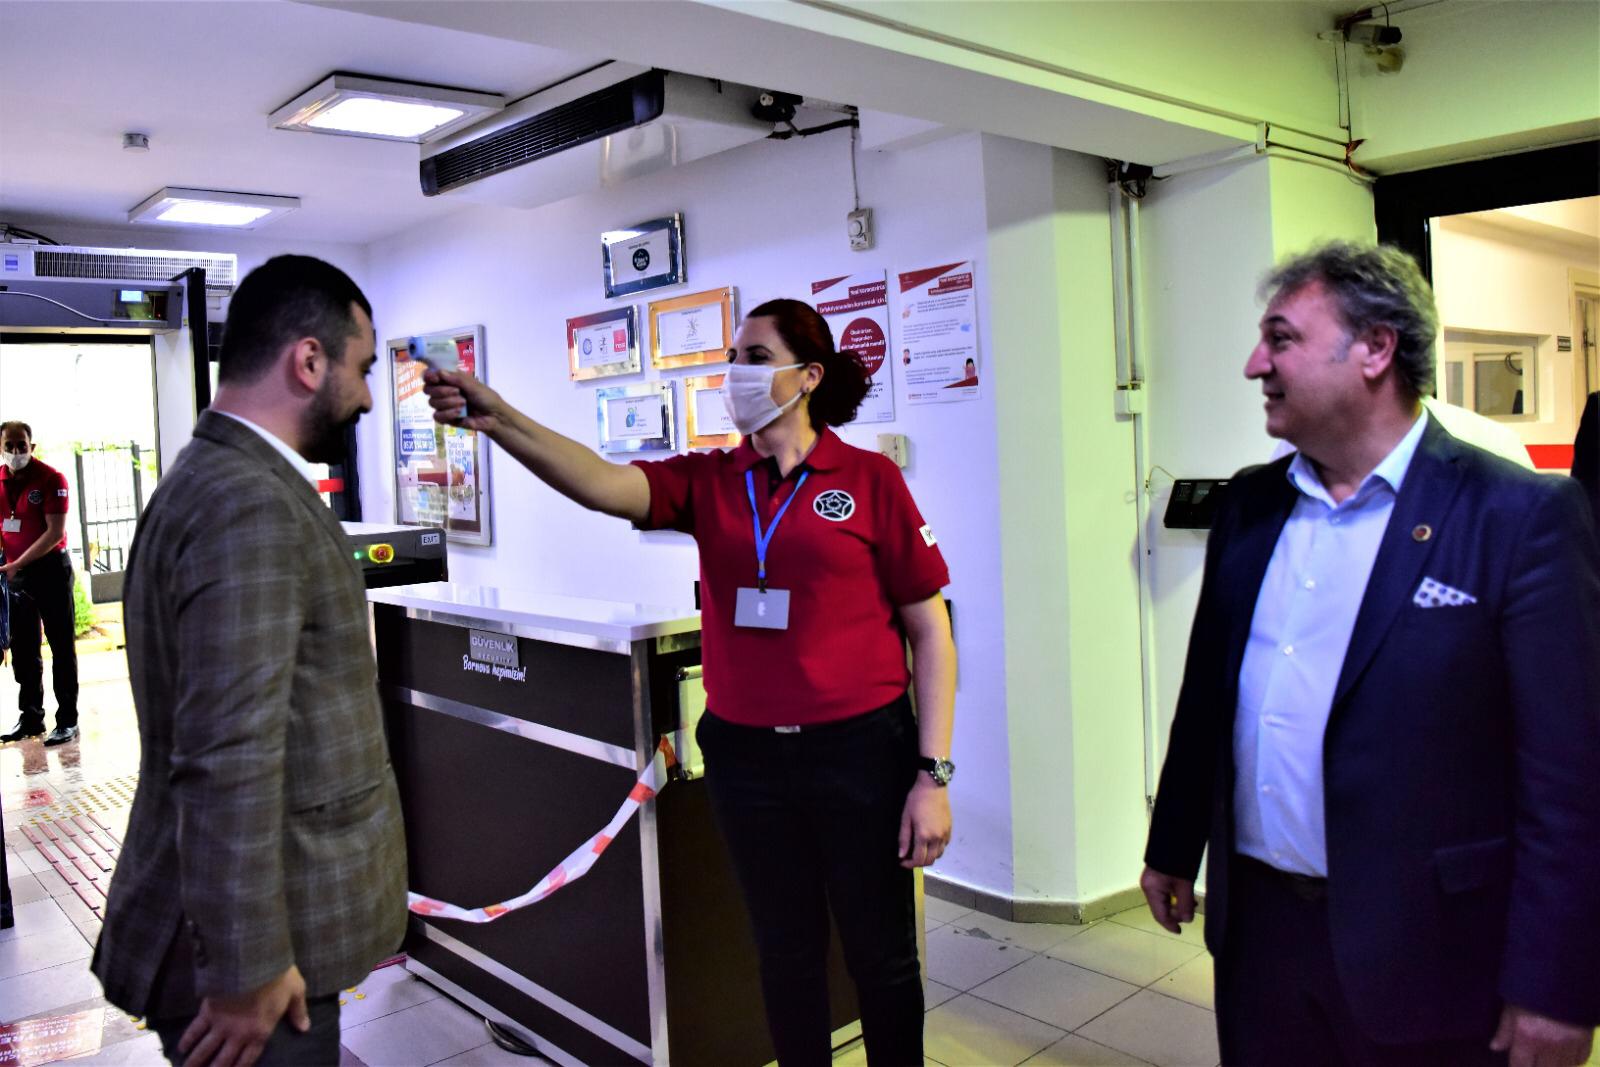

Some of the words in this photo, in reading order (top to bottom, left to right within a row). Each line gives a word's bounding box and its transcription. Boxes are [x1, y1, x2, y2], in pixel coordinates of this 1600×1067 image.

[423, 535, 438, 544] EXIT
[471, 634, 515, 653] GÜVENLİK
[462, 654, 491, 674] Bornova
